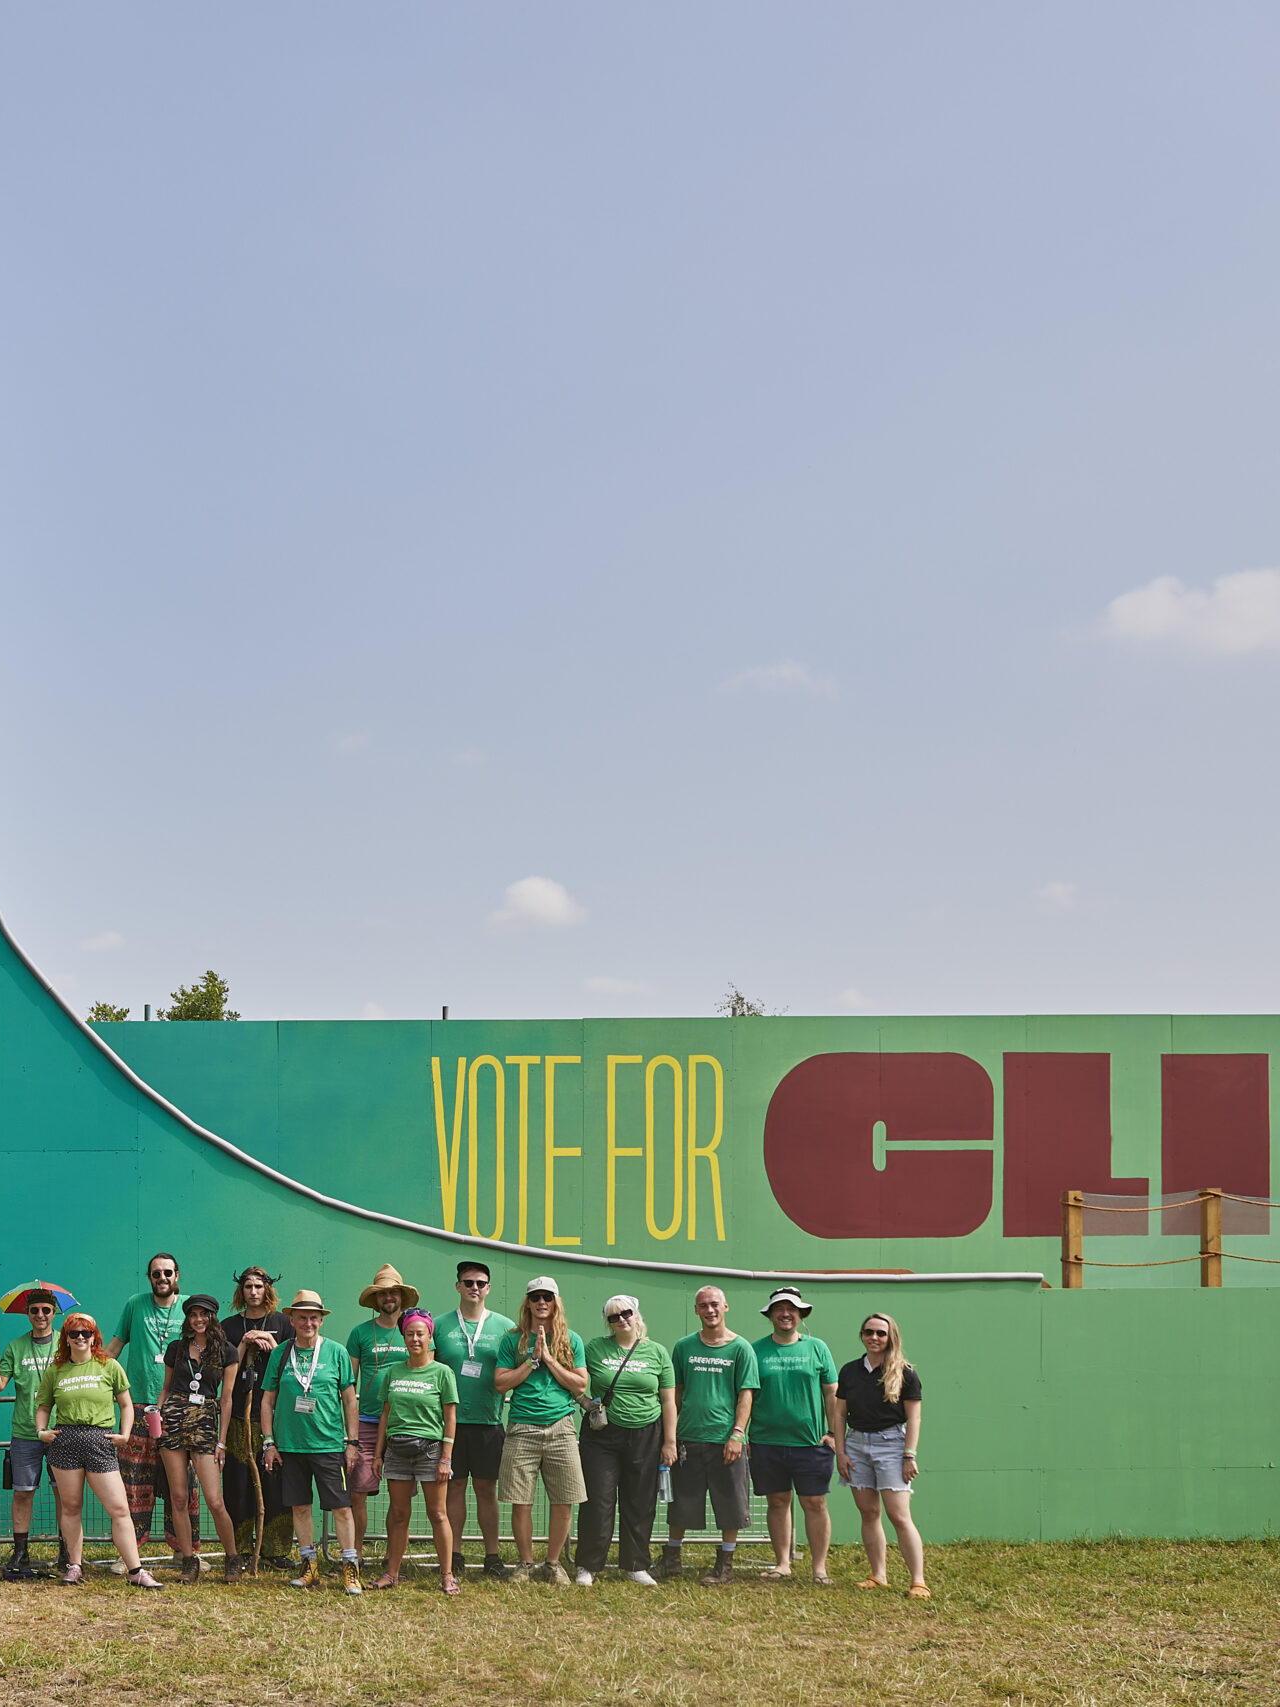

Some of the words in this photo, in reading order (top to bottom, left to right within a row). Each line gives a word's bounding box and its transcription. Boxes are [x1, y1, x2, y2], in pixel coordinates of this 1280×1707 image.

[431, 1054, 582, 1246] VOTE
[607, 1054, 725, 1244] FOR
[763, 1051, 1270, 1239] CLI
[689, 1356, 734, 1367] GREENPEACE
[59, 1375, 103, 1387] GREENPEACE
[64, 1385, 79, 1393] JOIN
